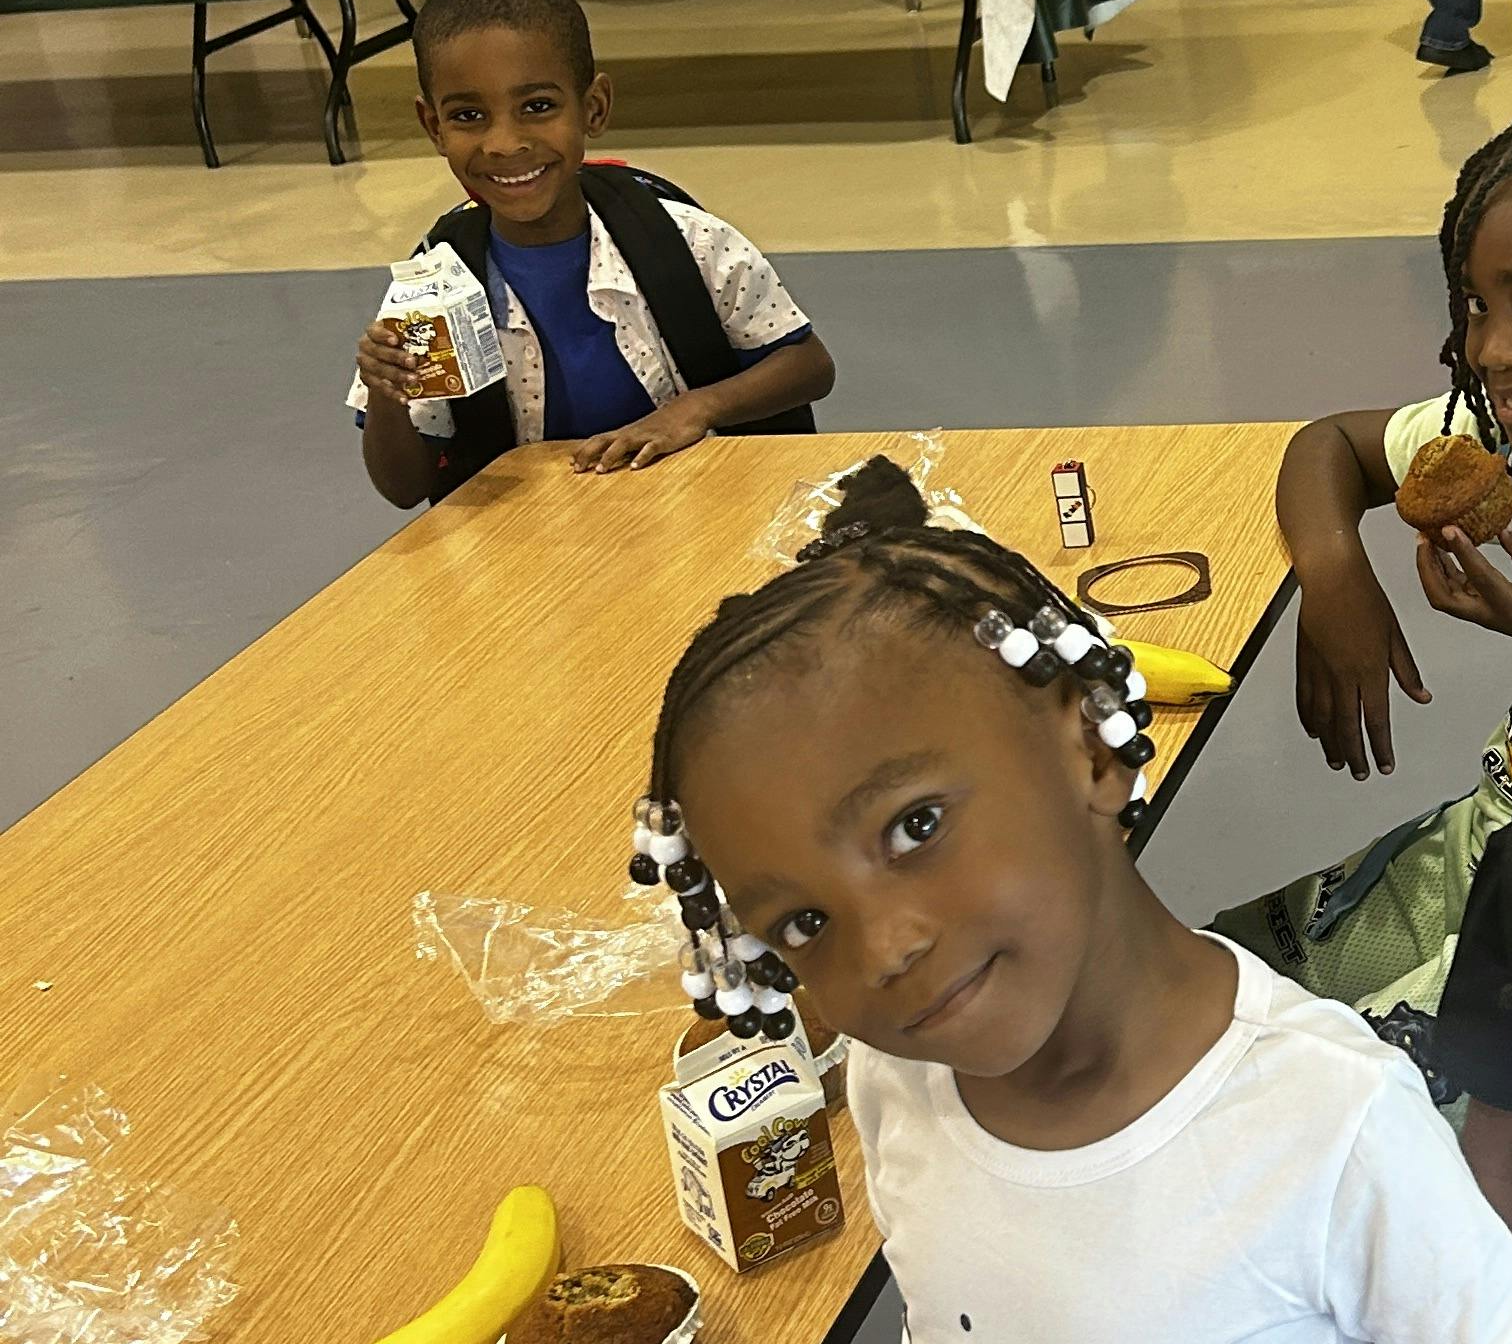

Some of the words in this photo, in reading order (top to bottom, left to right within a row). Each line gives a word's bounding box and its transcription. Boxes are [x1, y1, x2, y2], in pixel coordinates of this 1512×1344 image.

[708, 1058, 799, 1123] CRYSTAL
[741, 1124, 774, 1164] Cool
[771, 1116, 809, 1138] Cow
[765, 1187, 815, 1224] Chocolate
